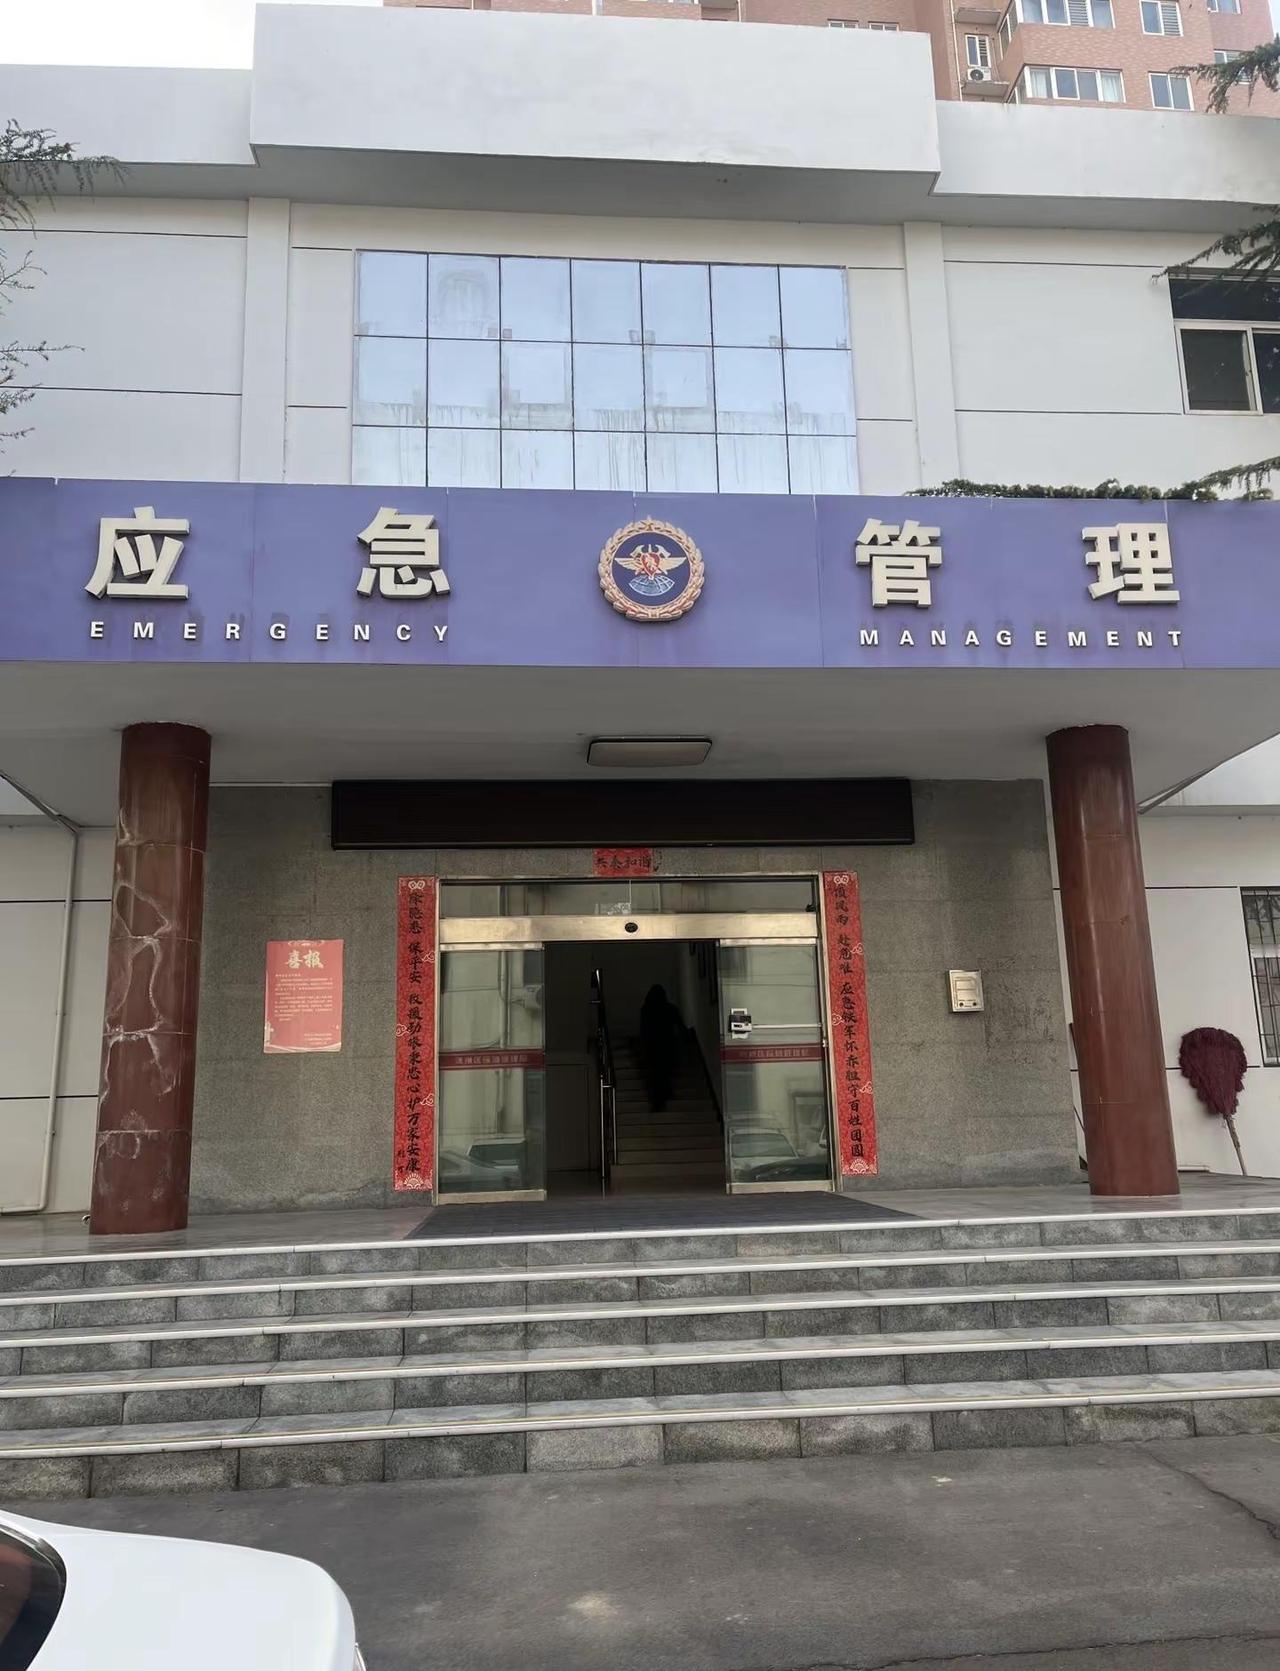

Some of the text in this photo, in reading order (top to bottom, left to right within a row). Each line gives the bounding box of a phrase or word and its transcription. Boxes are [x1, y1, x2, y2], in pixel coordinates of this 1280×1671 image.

[85, 506, 1180, 608] 应急 管理
[89, 621, 1183, 648] EMERGENCY MANAGEMENT
[285, 949, 324, 969] 喜报
